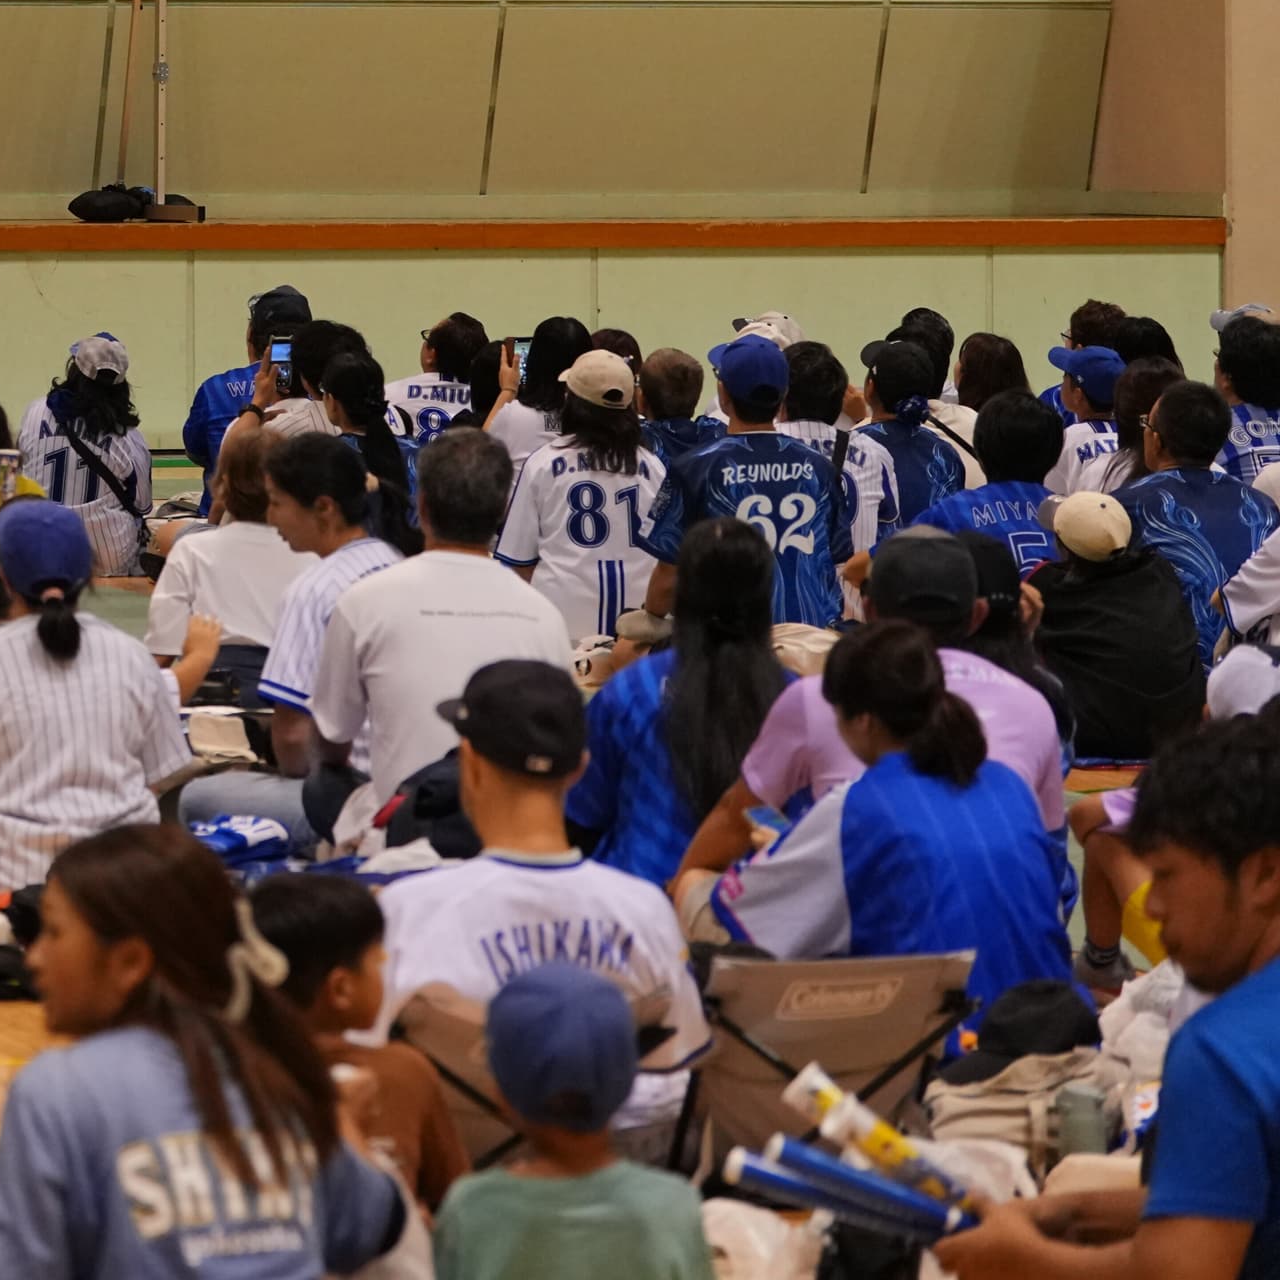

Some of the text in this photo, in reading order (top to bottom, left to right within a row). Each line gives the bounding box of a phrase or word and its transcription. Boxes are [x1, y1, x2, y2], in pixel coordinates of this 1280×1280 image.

[407, 384, 471, 404] D.MIU
[721, 462, 815, 488] REYNOLDS
[566, 480, 642, 549] 81
[735, 492, 818, 555] 62
[971, 500, 1040, 529] MIYA
